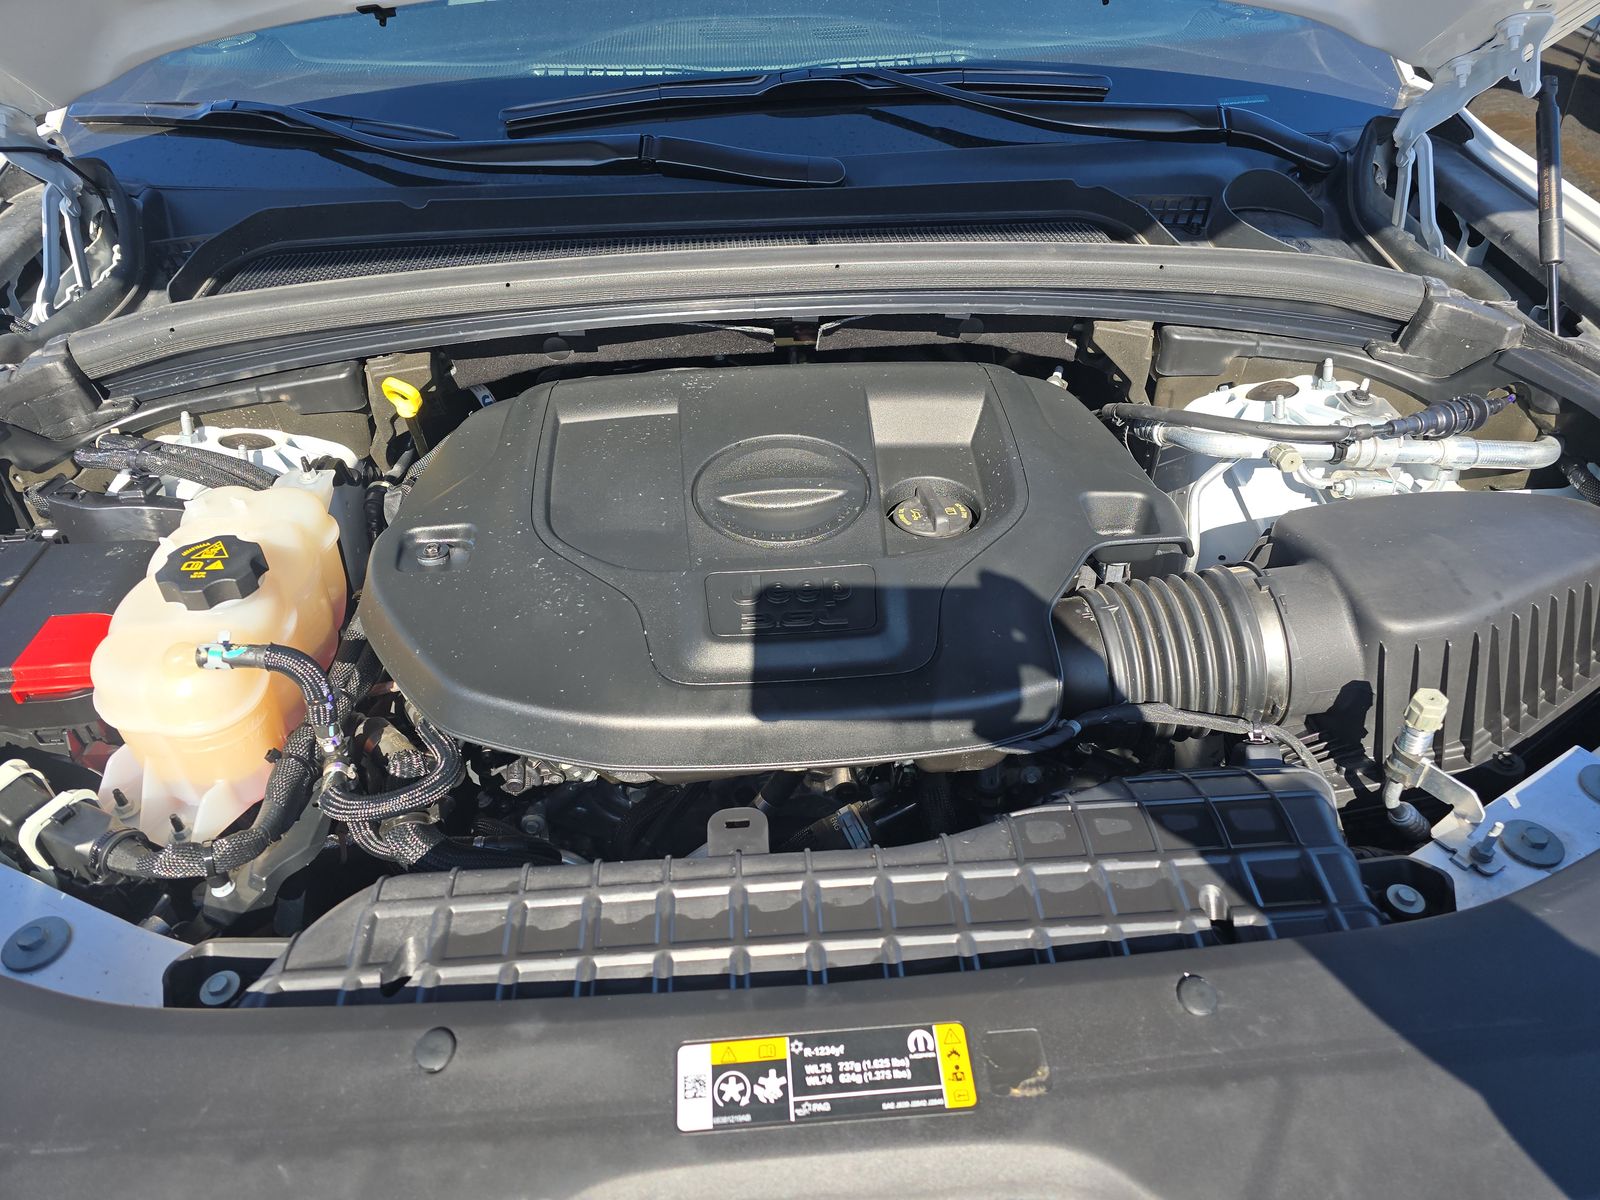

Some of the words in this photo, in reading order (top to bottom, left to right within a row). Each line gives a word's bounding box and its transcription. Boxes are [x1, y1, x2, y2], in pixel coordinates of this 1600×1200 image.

[730, 575, 852, 607] Jeep
[803, 1044, 845, 1057] R-1234yf
[804, 1063, 832, 1075] WL75
[837, 1061, 862, 1072] 737g
[805, 1074, 834, 1086] WL74
